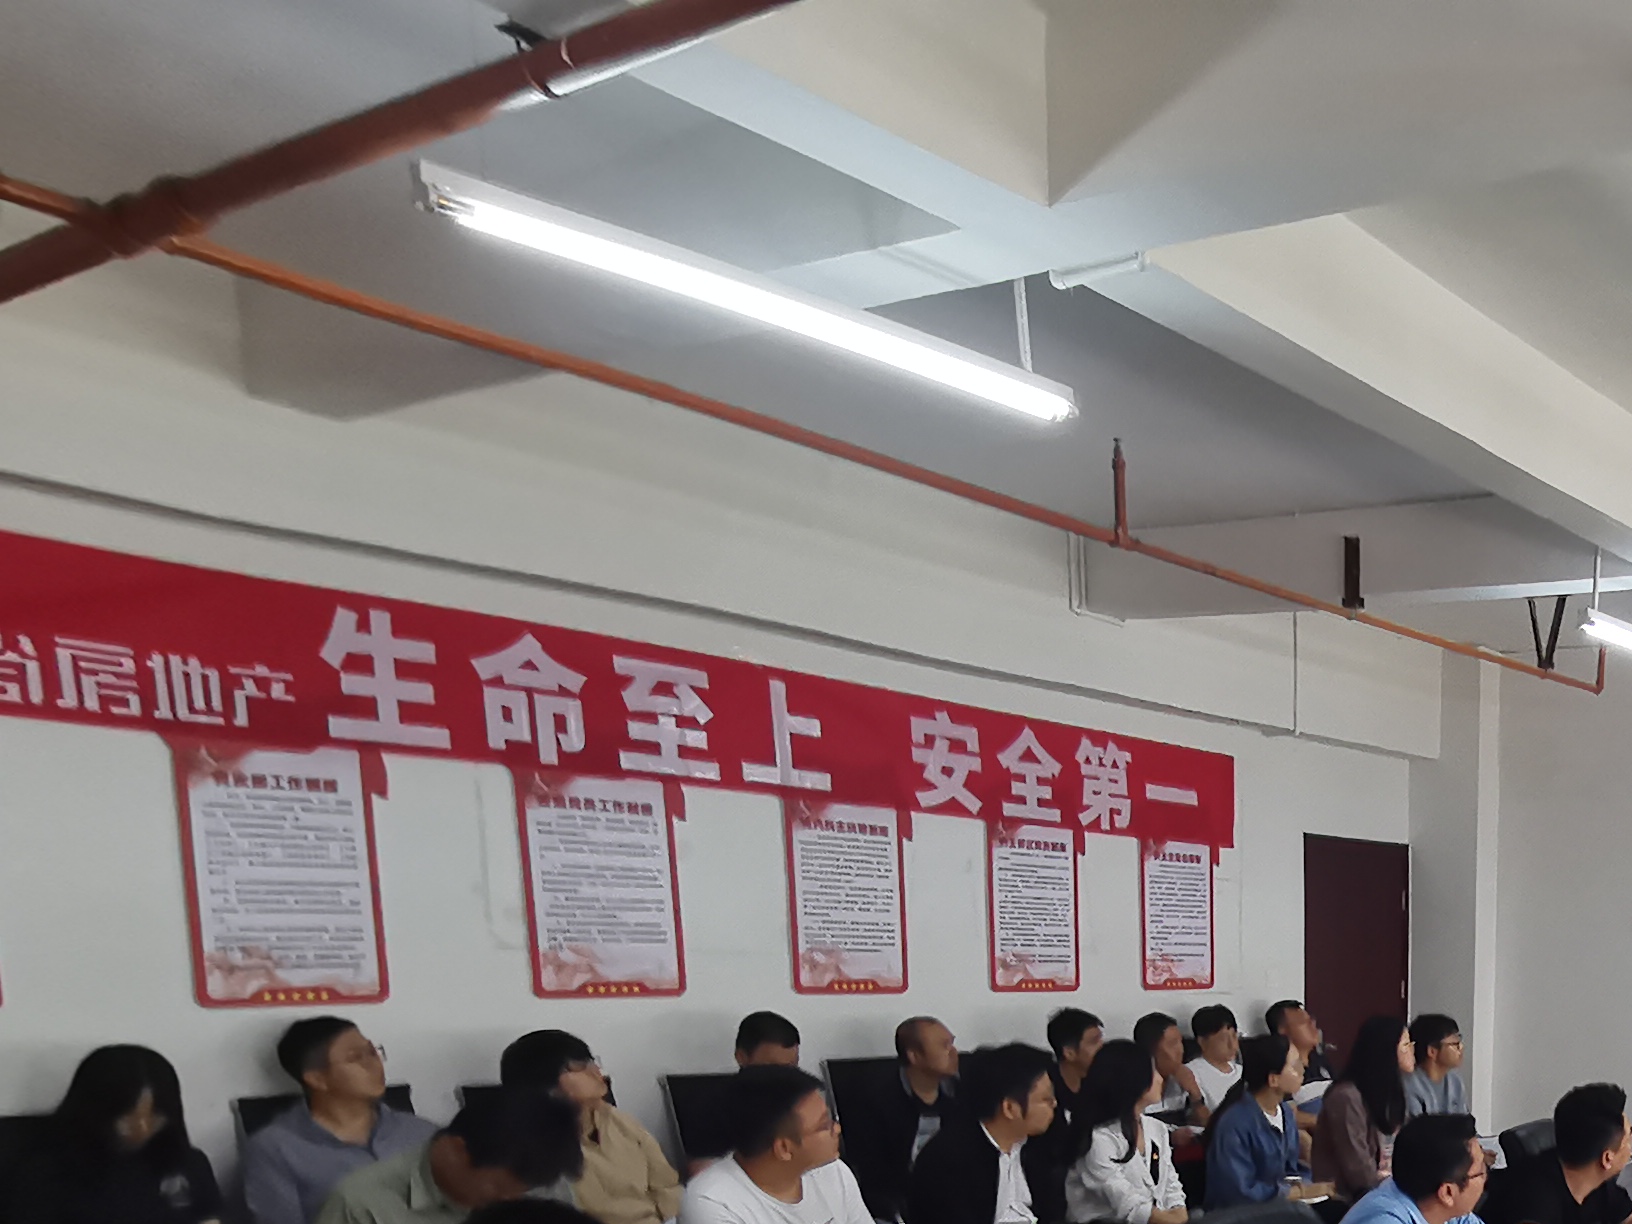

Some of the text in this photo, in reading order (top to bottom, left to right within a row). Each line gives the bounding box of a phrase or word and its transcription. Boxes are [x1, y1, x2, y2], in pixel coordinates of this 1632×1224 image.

[319, 603, 832, 792] 生命至上
[909, 710, 1199, 831] 安全第一
